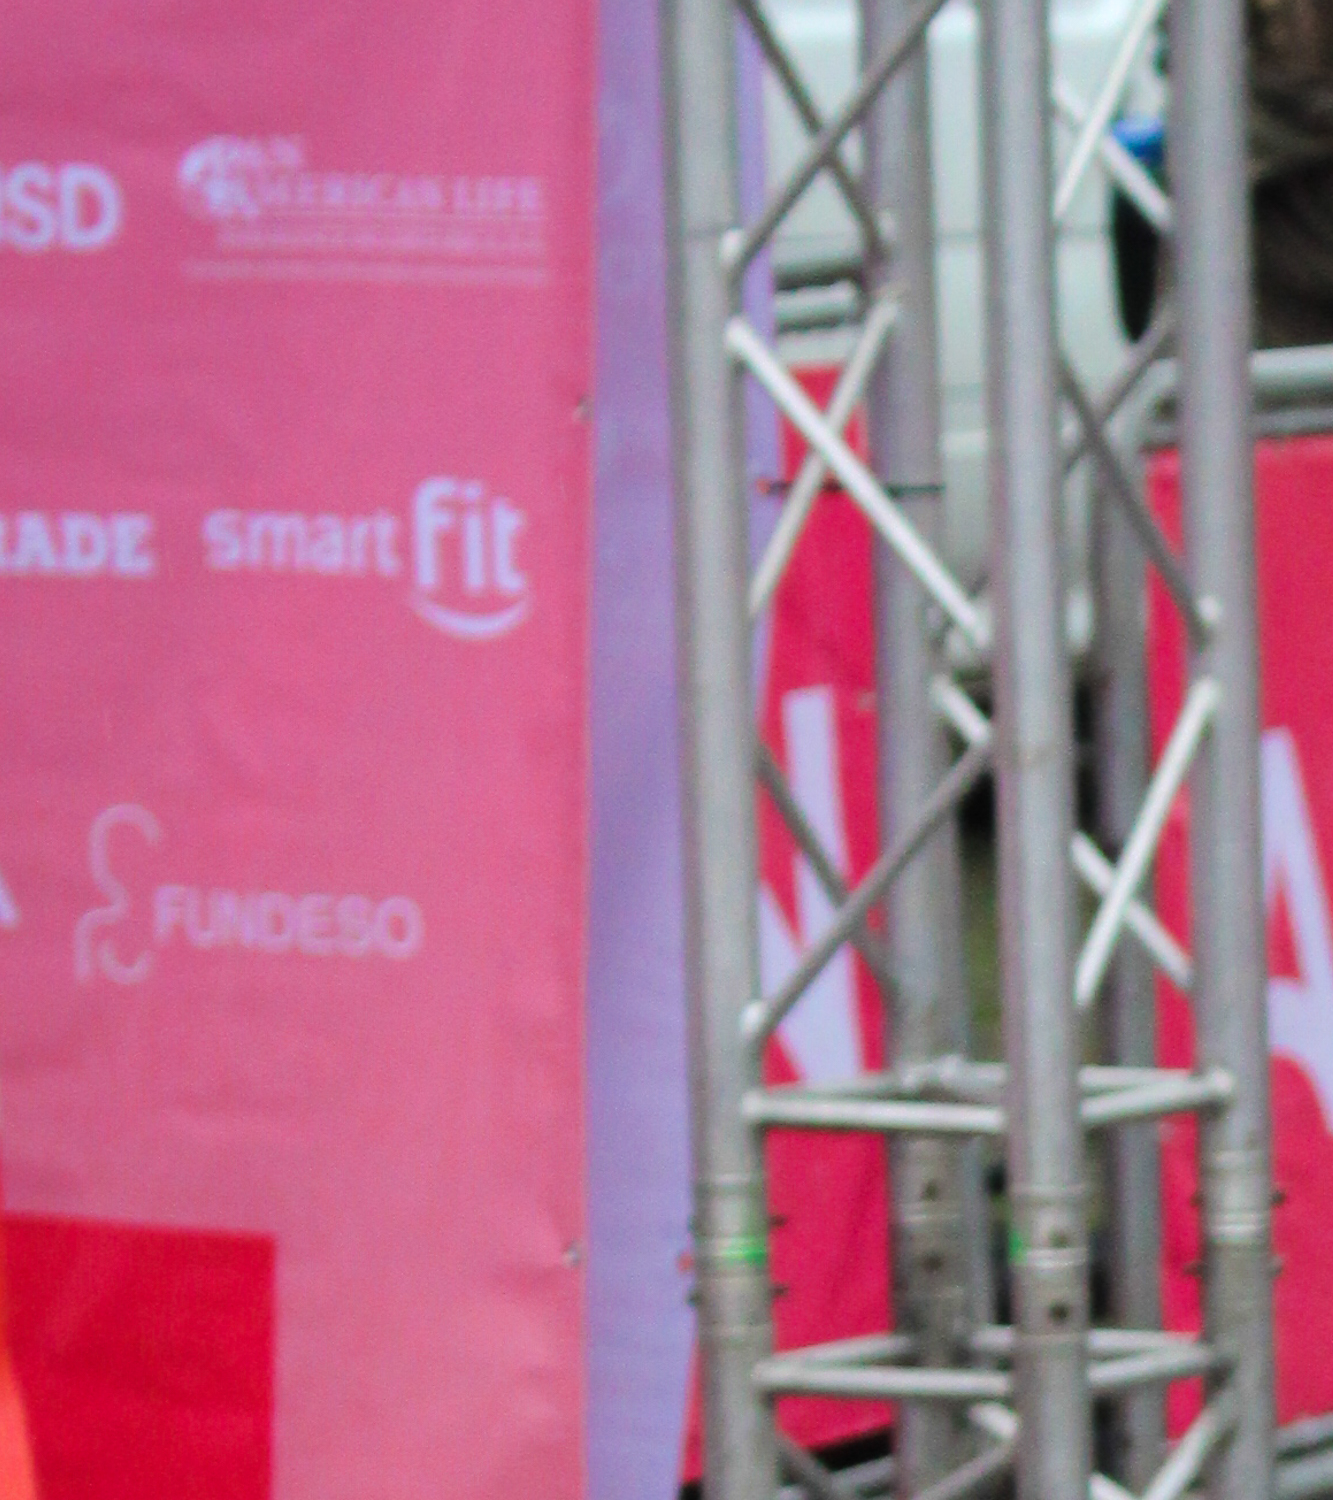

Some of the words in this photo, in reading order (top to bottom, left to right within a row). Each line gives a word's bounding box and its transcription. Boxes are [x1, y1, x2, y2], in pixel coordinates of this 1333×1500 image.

[0, 161, 122, 254] SD
[0, 509, 156, 577] ADE
[154, 884, 424, 960] FUNDESO
